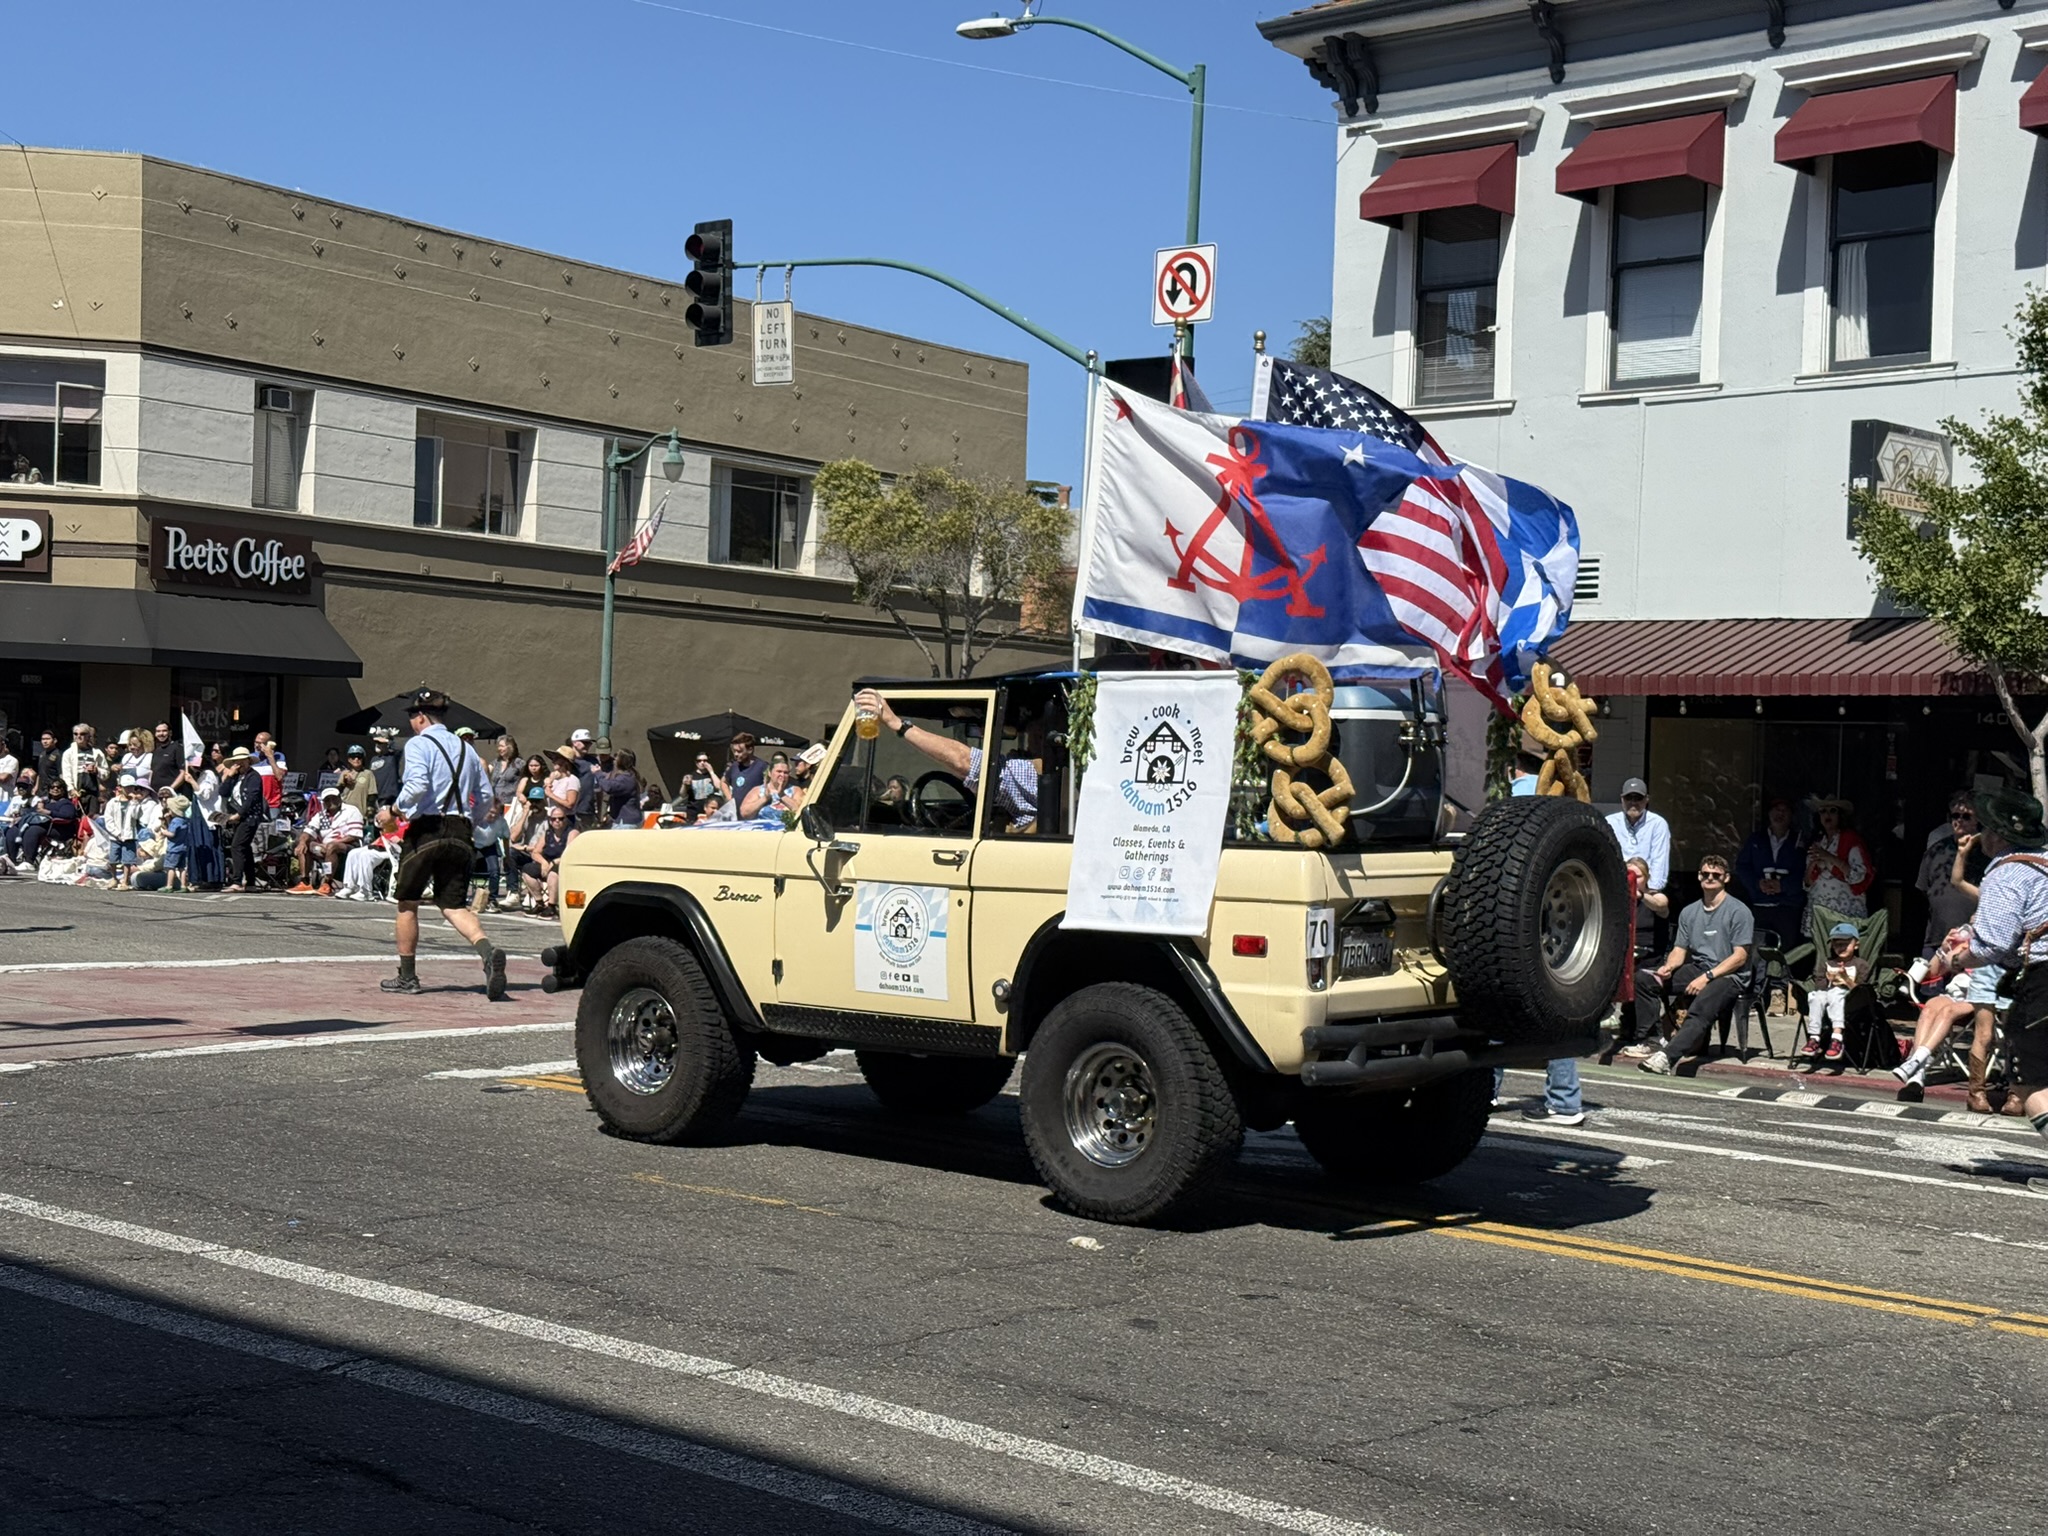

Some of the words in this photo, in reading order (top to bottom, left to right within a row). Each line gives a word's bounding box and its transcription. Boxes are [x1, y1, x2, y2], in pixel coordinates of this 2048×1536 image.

[766, 308, 780, 319] NO
[760, 323, 786, 335] LEFT
[759, 338, 787, 350] TURN
[162, 526, 229, 575] Peet's
[233, 537, 305, 586] Coffee
[1120, 725, 1140, 764] brew
[1152, 703, 1181, 719] cook
[1190, 726, 1205, 765] meet
[1162, 825, 1171, 833] CA
[1112, 836, 1145, 849] Classes,
[1148, 838, 1176, 849] Events
[1178, 839, 1185, 849] &
[1124, 850, 1169, 864] Gatherings
[713, 885, 762, 902] Bronco
[1309, 919, 1329, 949] 70
